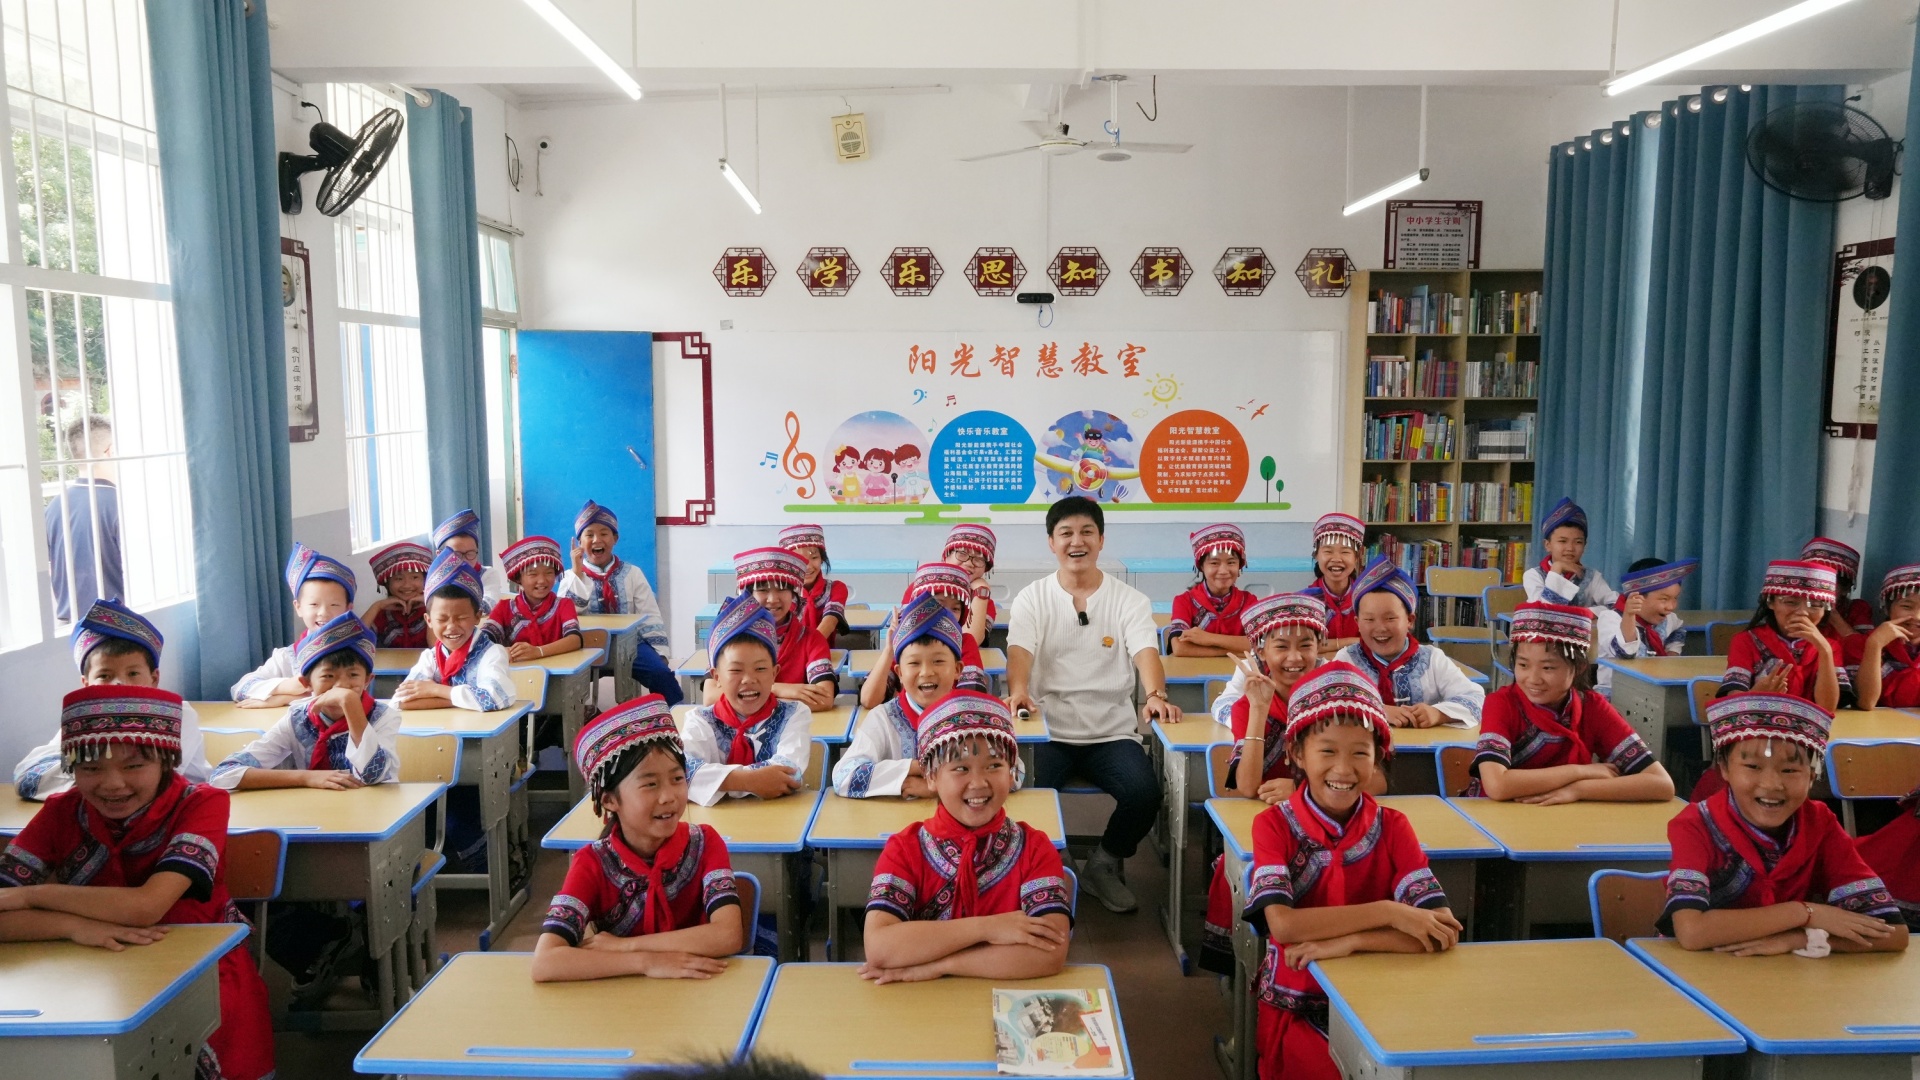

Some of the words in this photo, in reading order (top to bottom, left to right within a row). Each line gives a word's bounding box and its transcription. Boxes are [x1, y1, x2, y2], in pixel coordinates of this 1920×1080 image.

[1406, 216, 1461, 225] 中小学生守则
[731, 258, 758, 286] 乐
[813, 257, 843, 287] 学
[898, 258, 925, 286] 乐
[979, 259, 1011, 285] 思
[1061, 259, 1097, 284] 知
[1148, 258, 1175, 285] 书
[1226, 261, 1262, 285] 知
[1307, 261, 1345, 286] 礼
[908, 342, 1147, 379] 阳光智慧教室
[957, 427, 1009, 436] 快乐音乐教室
[1169, 426, 1221, 435] 阳光智慧教室
[954, 441, 1023, 449] 阳光新能源携手中国社会
